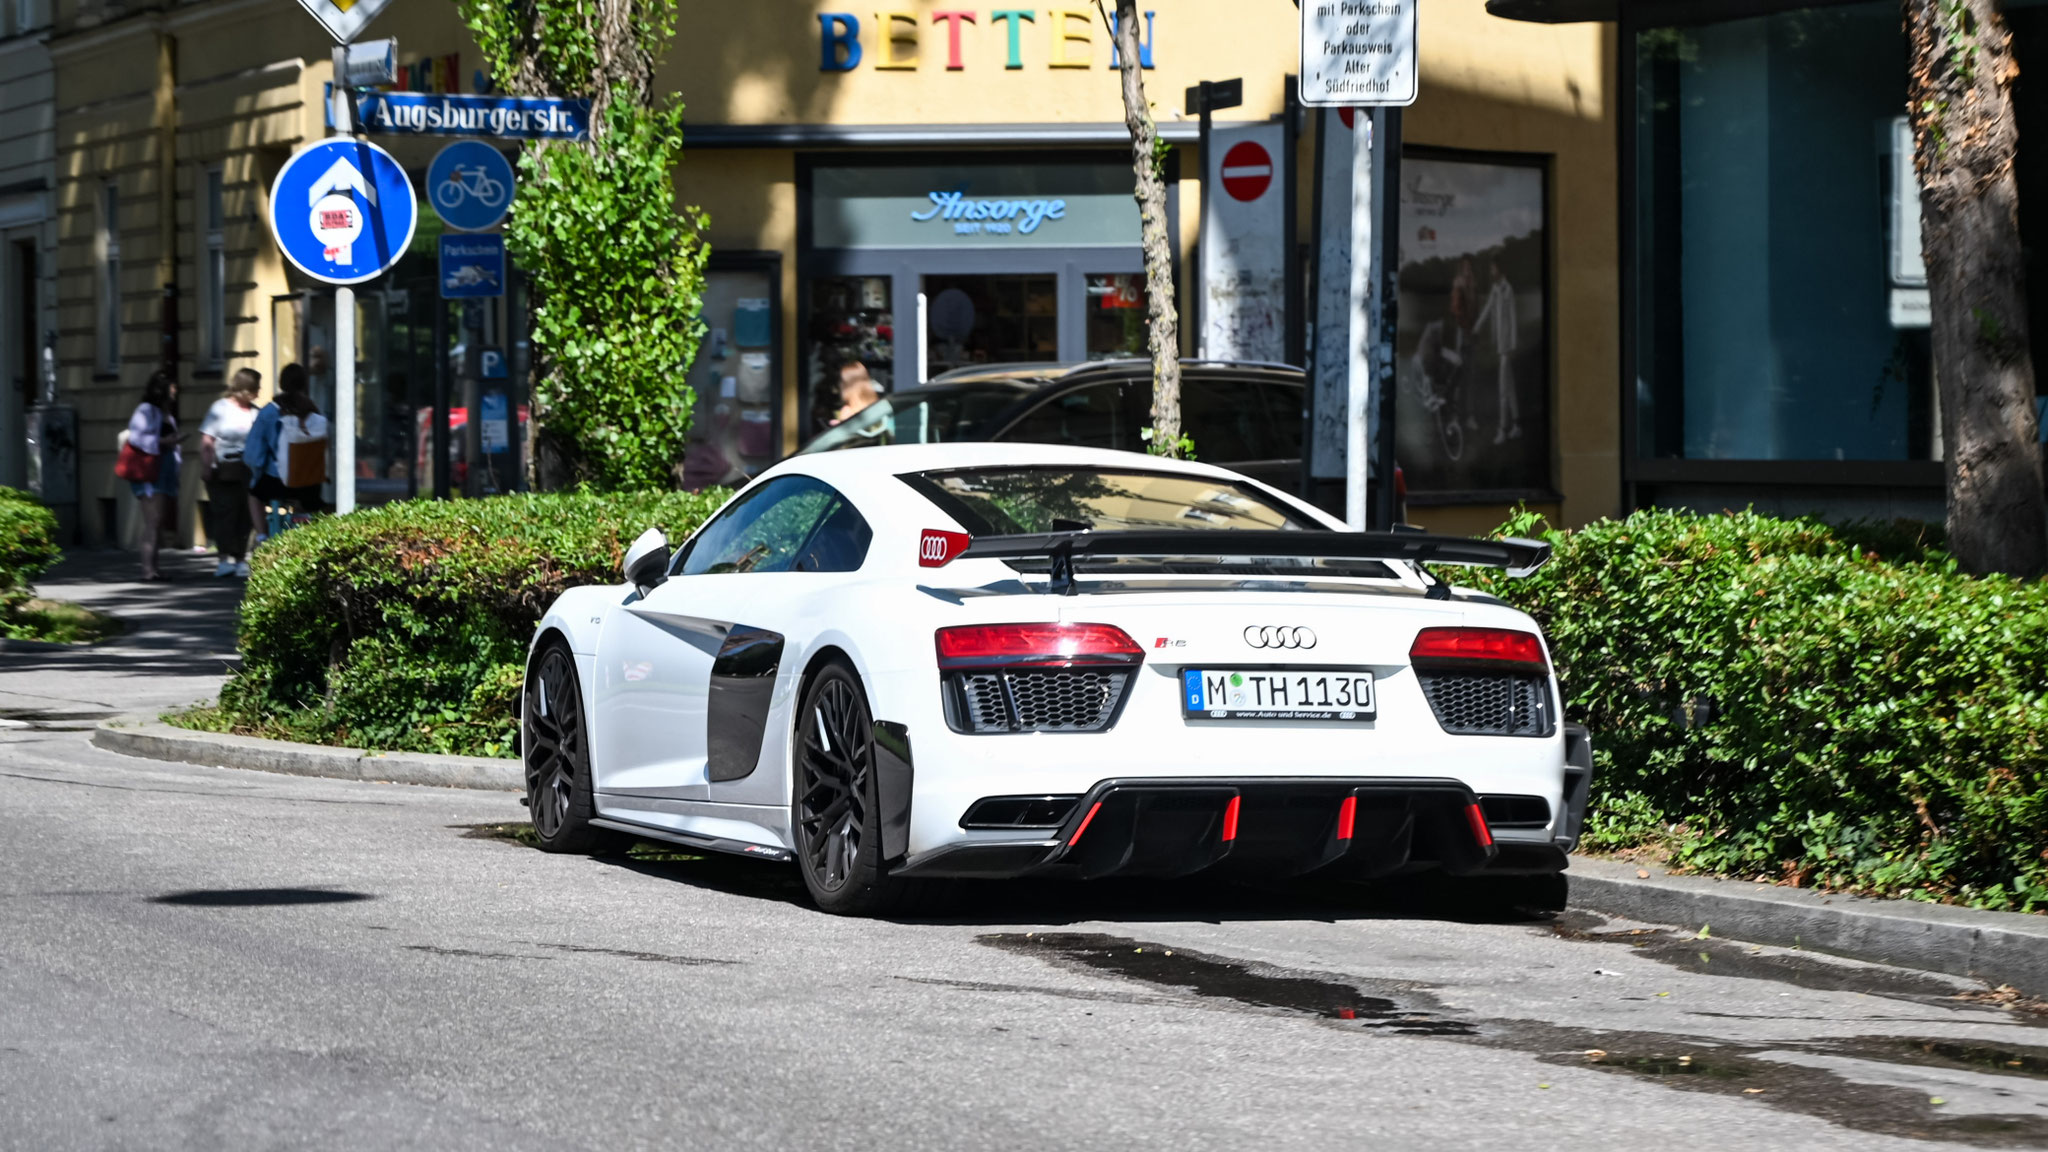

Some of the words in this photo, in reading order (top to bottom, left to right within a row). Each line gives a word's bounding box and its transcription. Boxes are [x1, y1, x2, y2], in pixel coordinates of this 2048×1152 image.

[1317, 3, 1335, 17] mit
[1341, 2, 1401, 16] Parkschein
[1346, 20, 1371, 36] oder
[1323, 39, 1393, 55] Parkausweis
[1344, 59, 1371, 75] Alter
[1325, 78, 1390, 94] Südfriedhof
[373, 97, 574, 136] Augsburgerstr.
[910, 191, 1066, 235] Ansorge
[1191, 694, 1200, 705] D
[1207, 676, 1227, 706] M
[1249, 677, 1289, 706] TH
[1297, 677, 1371, 707] 1130
